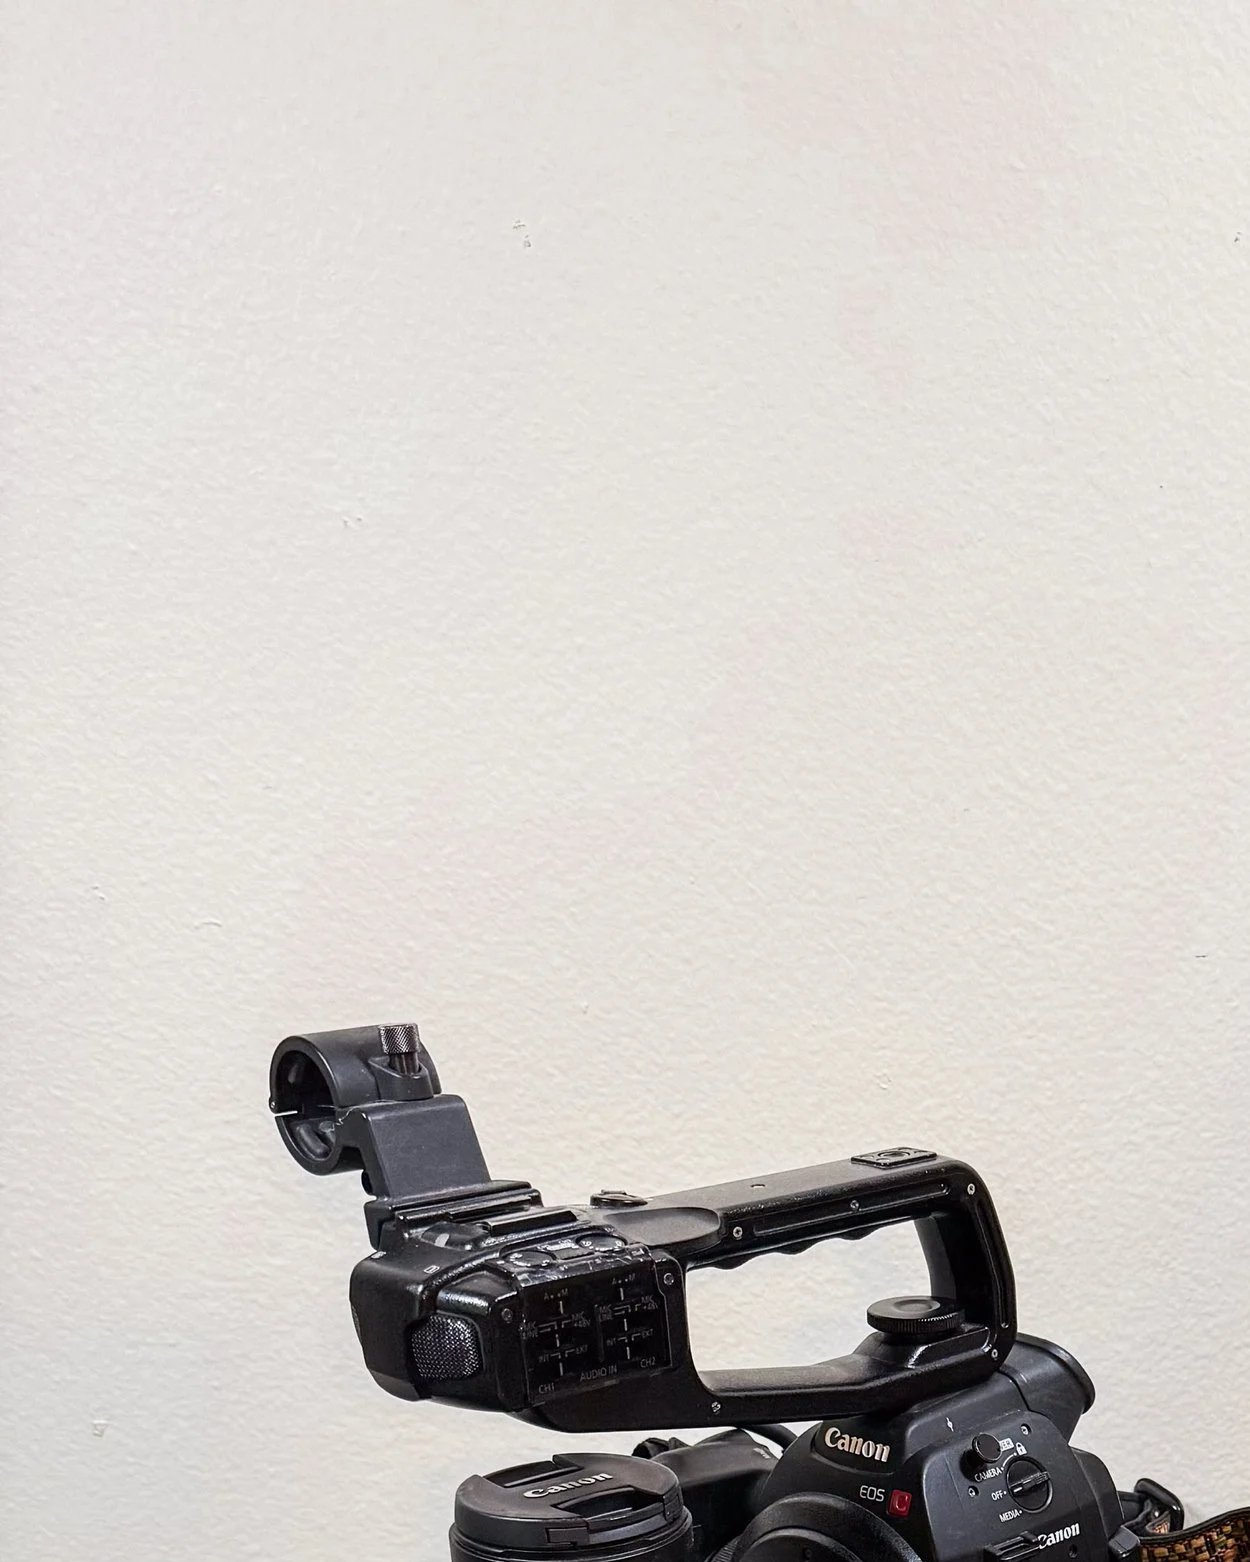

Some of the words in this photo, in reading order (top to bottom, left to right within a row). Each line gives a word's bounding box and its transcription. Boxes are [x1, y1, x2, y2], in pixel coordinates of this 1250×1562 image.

[824, 1426, 891, 1464] Canon
[974, 1467, 1002, 1483] CAMERA
[523, 1471, 613, 1499] Canon
[860, 1484, 885, 1502] EOS
[991, 1489, 1004, 1502] OFF
[999, 1510, 1020, 1523] MEDIA
